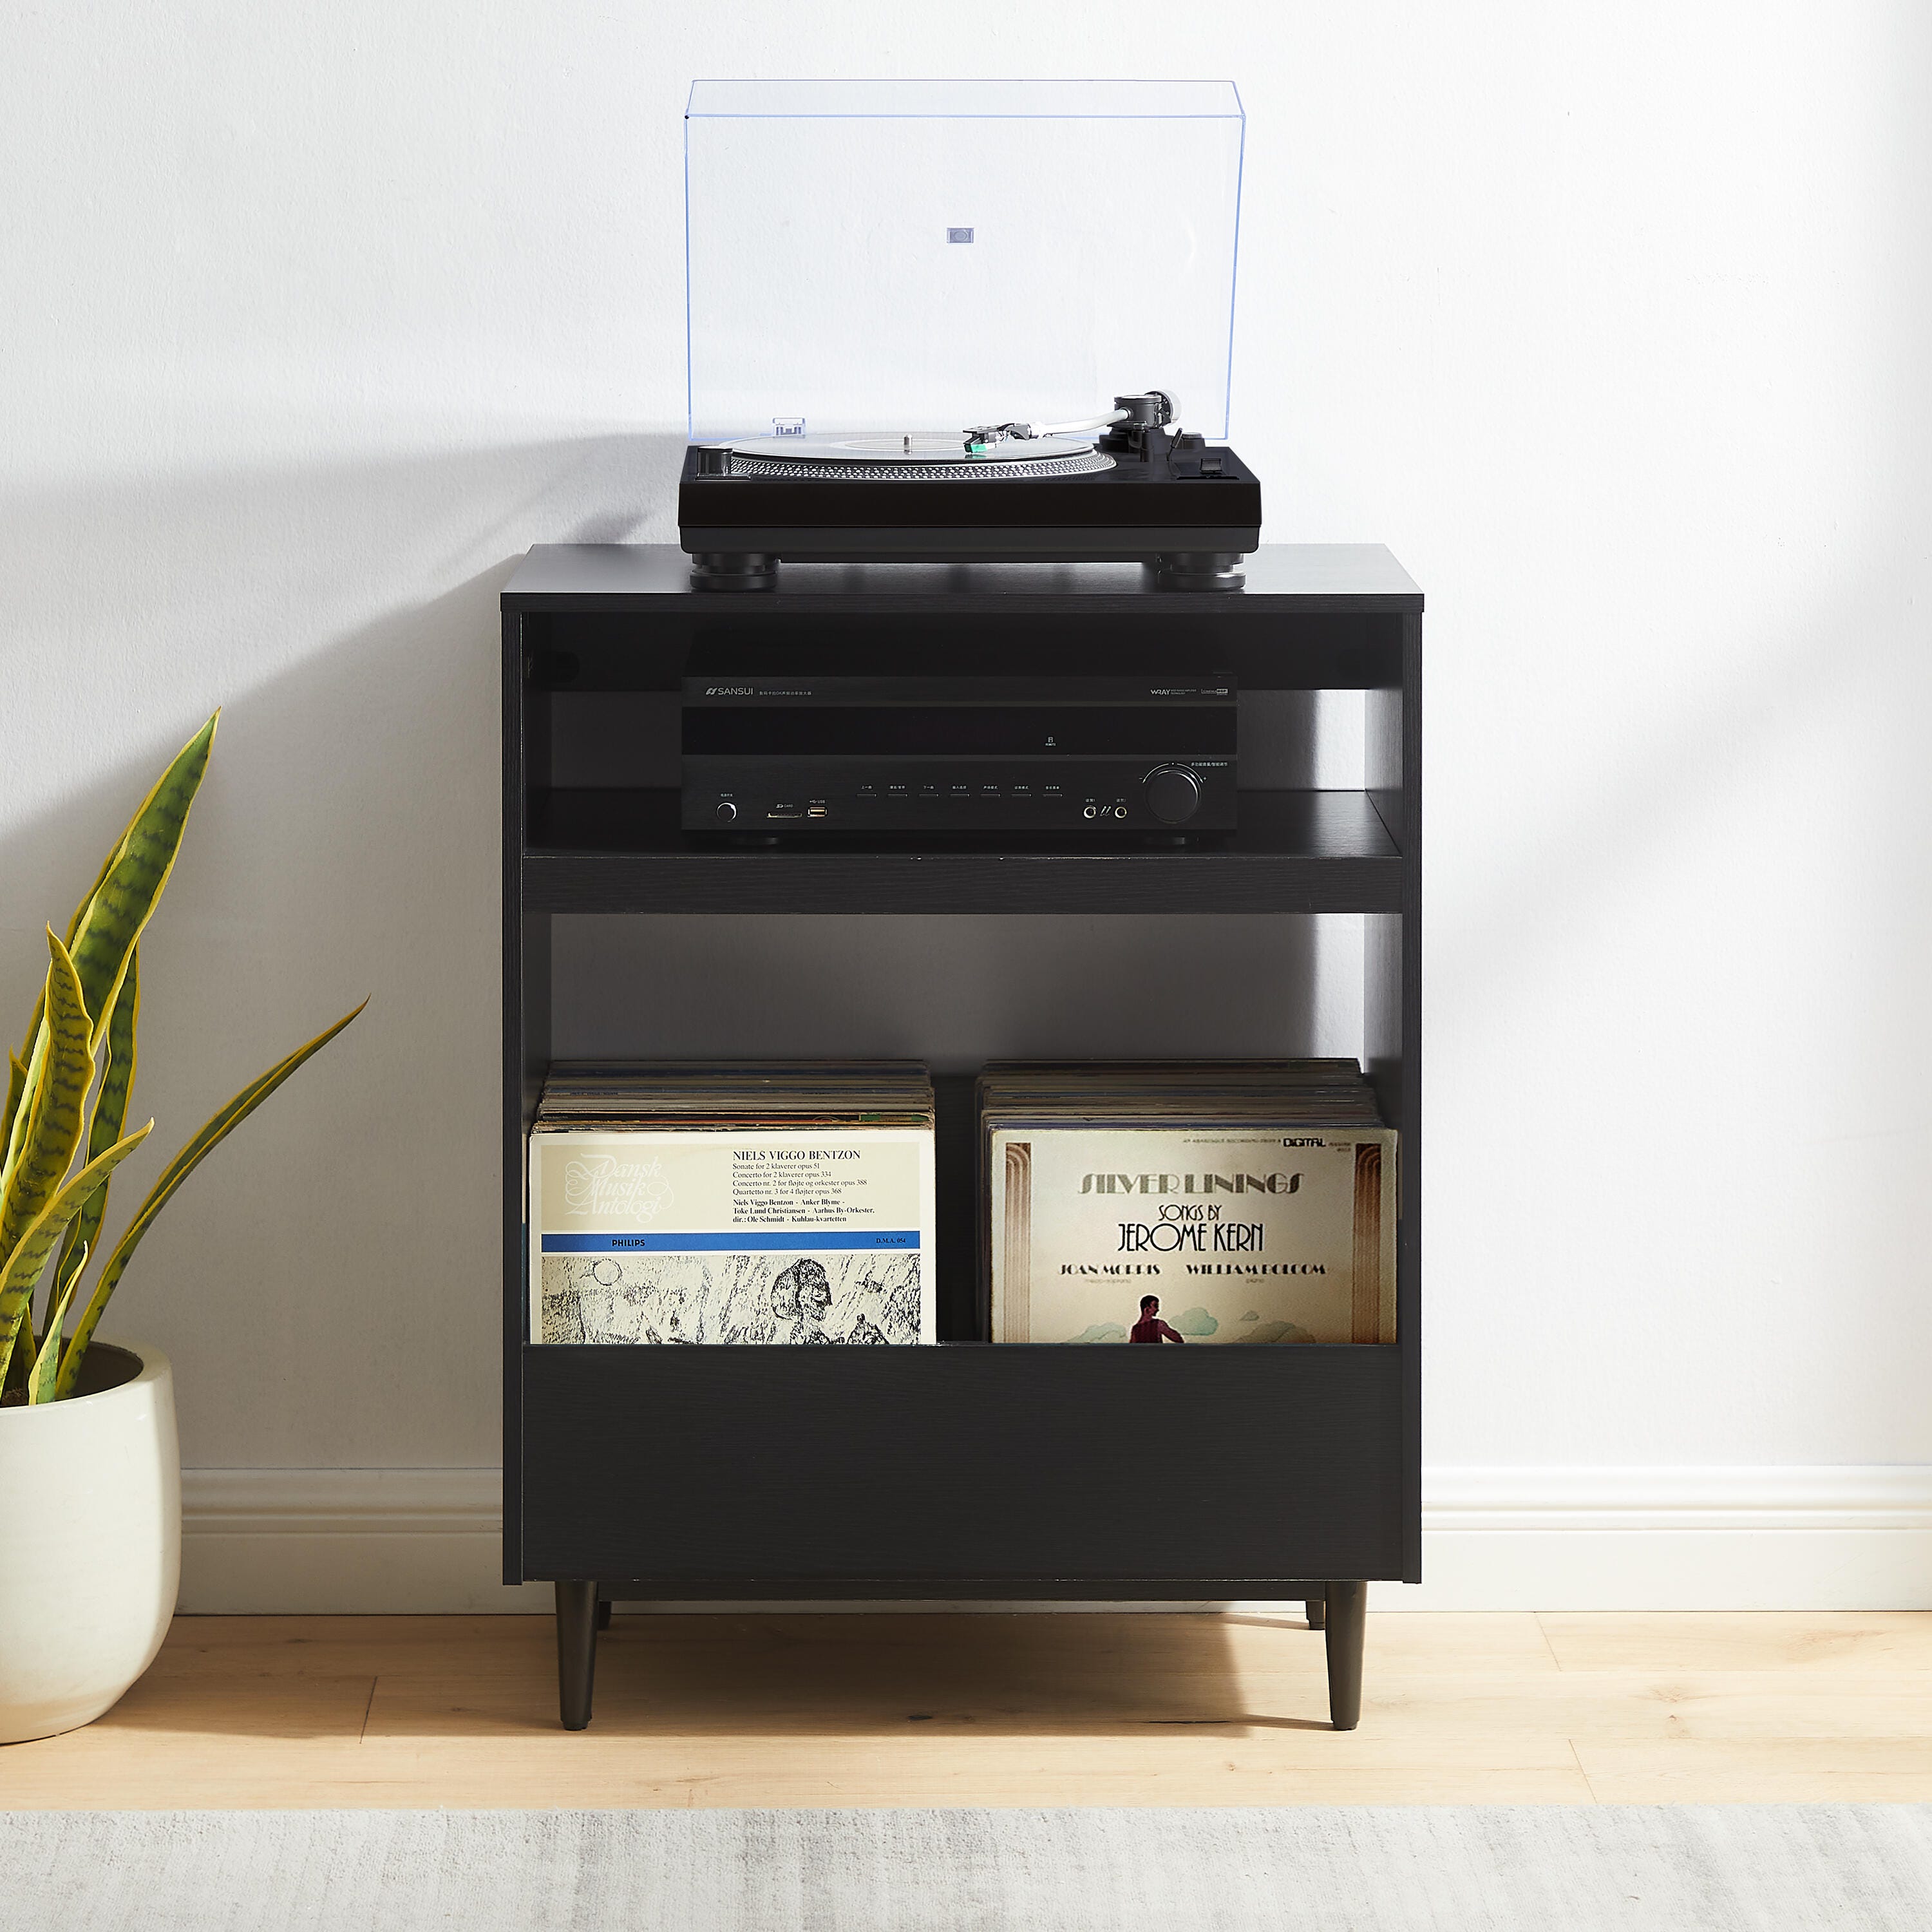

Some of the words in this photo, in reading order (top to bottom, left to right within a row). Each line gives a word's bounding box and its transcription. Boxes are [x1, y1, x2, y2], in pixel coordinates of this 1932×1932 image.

[1283, 1137, 1326, 1147] DIGITAL
[733, 1151, 766, 1160] NIELS
[770, 1151, 805, 1160] VIGGO
[810, 1150, 860, 1160] BENTZON
[577, 1153, 662, 1178] Dansk
[1077, 1173, 1180, 1195] SILVER
[1184, 1173, 1304, 1195] LININGS
[565, 1196, 663, 1224] Antologi
[1158, 1204, 1204, 1221] SONGS
[1208, 1205, 1222, 1221] BY
[612, 1238, 645, 1247] PHILIPS
[1117, 1224, 1207, 1251] JEROME
[1214, 1224, 1263, 1251] KERN
[1059, 1264, 1098, 1275] JOAN
[1103, 1264, 1160, 1274] MORRIS
[1186, 1264, 1258, 1274] WILLIAM
[1262, 1264, 1326, 1274] BOLCOM
